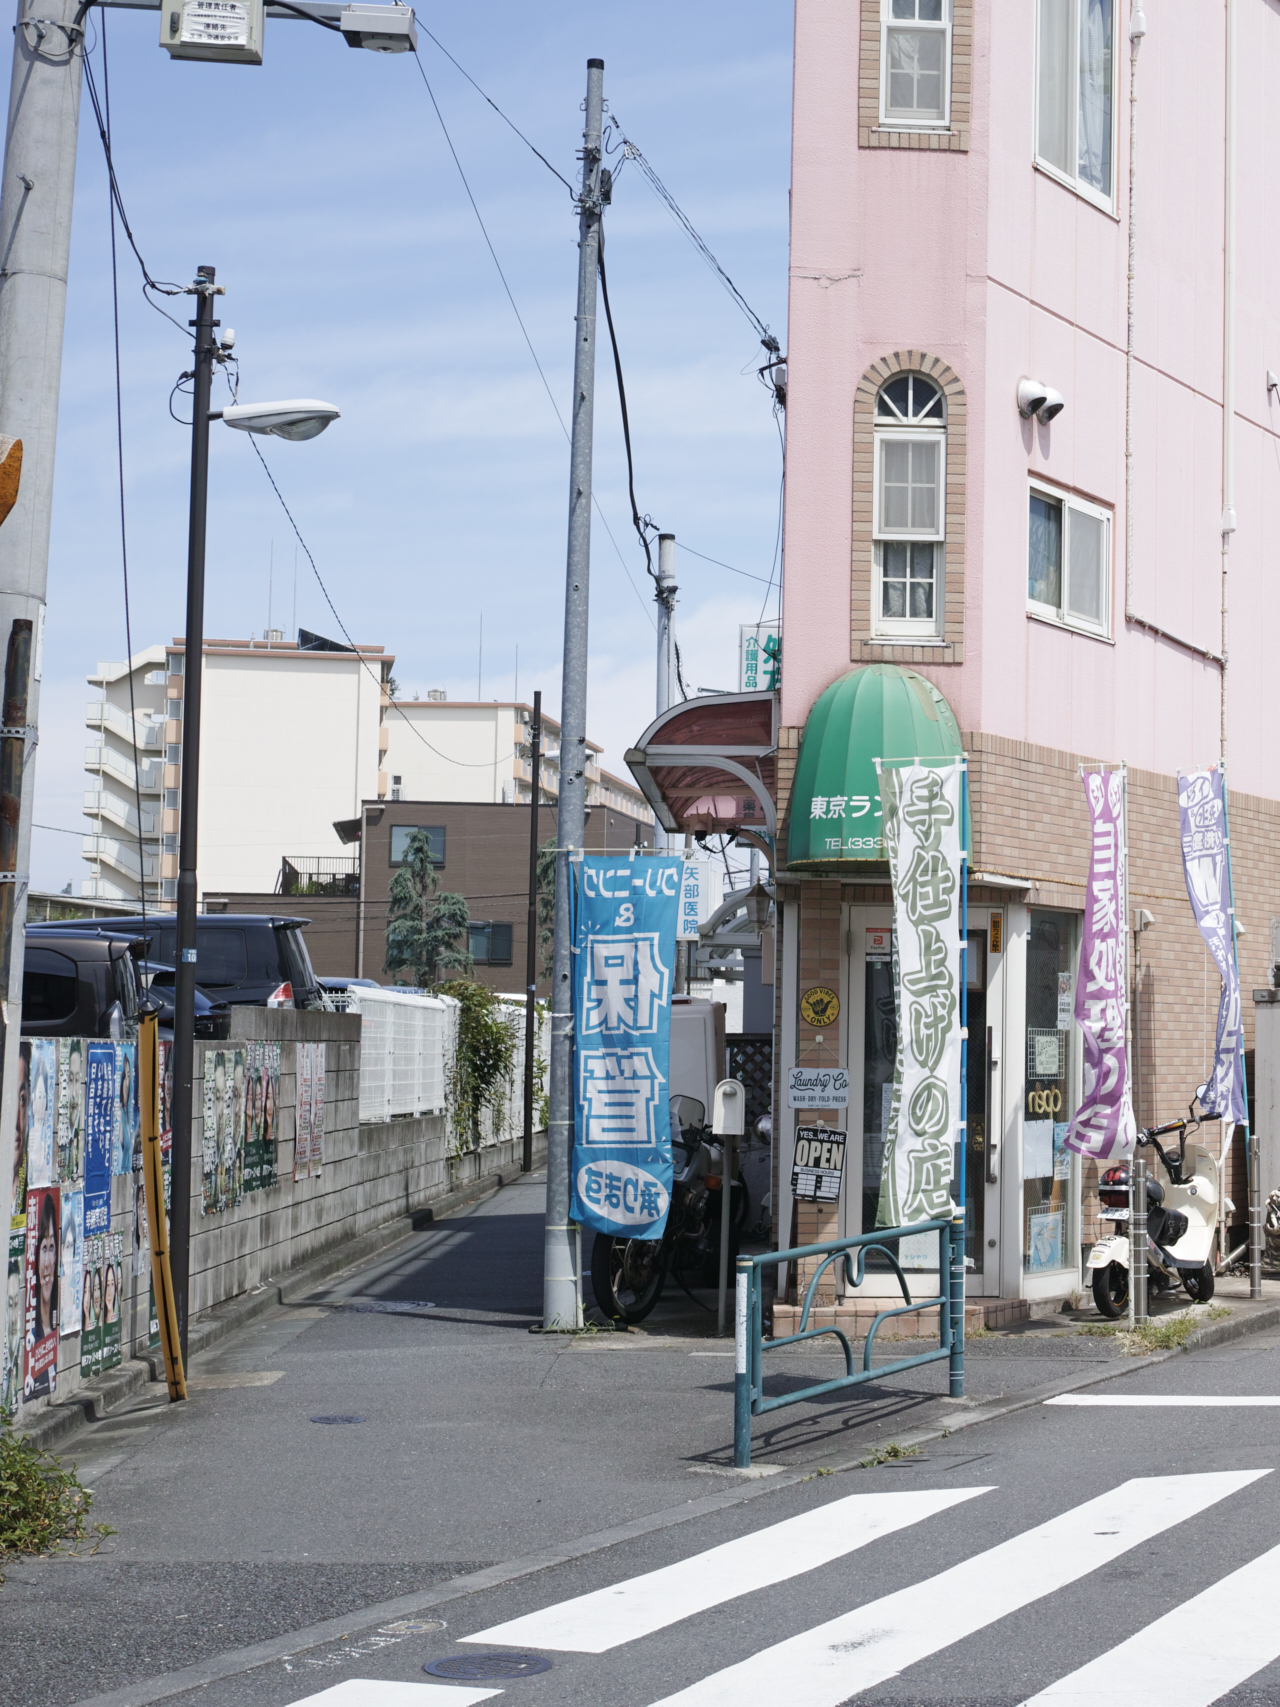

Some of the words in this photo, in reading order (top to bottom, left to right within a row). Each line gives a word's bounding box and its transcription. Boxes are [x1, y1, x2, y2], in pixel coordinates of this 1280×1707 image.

[203, 22, 228, 31] 連絡先
[745, 636, 758, 688] 介護用品
[683, 865, 700, 935] 矢部医院
[804, 989, 819, 1001] GOOD
[819, 988, 836, 1000] VIBES
[900, 769, 956, 1223] 手仕上げの店
[810, 1014, 832, 1025] ONLY
[789, 1070, 831, 1093] Laundry
[832, 1071, 849, 1091] Co
[829, 1134, 845, 1142] ARE
[795, 1139, 845, 1170] OPEN
